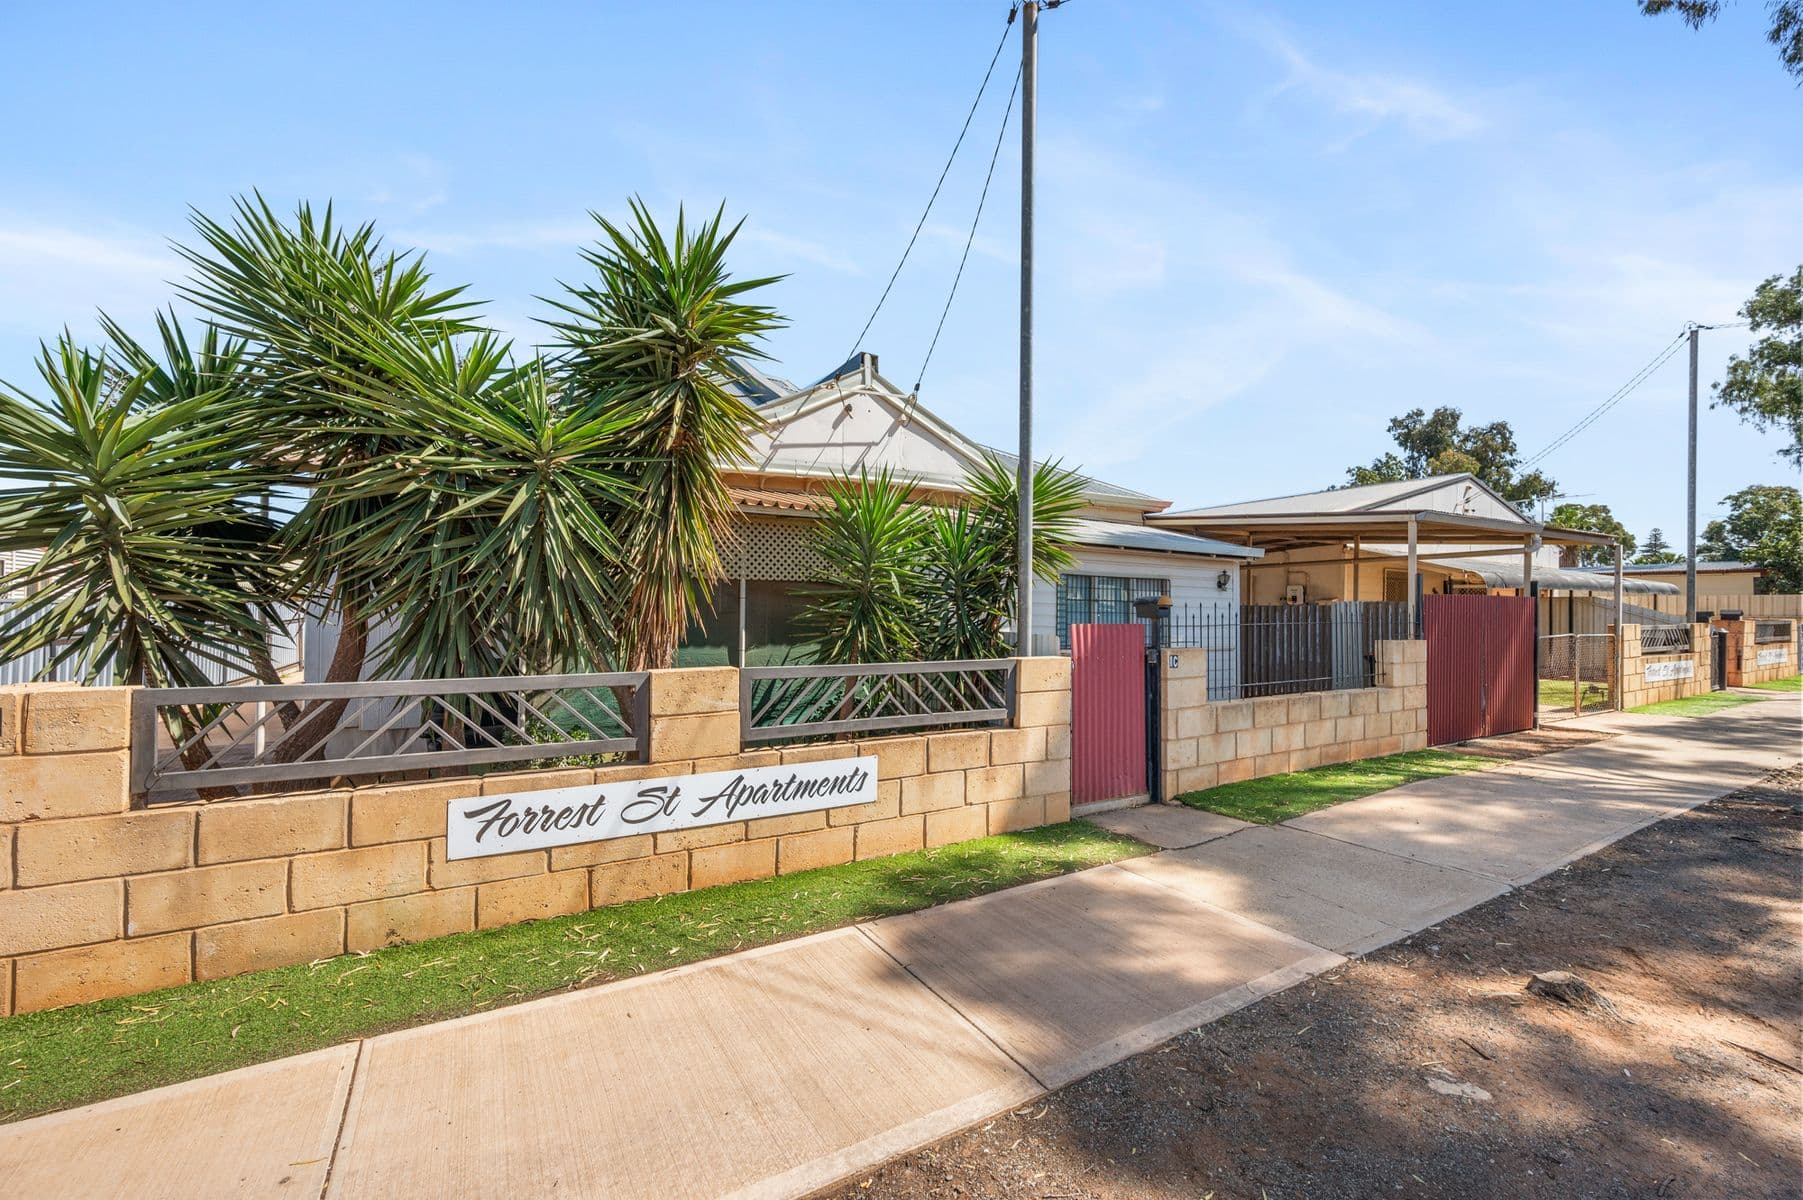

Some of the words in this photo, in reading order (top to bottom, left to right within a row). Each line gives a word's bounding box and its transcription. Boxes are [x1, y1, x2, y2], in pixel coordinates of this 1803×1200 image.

[464, 795, 605, 843] Forrest
[620, 786, 681, 824] St
[691, 767, 868, 818] Apartments
